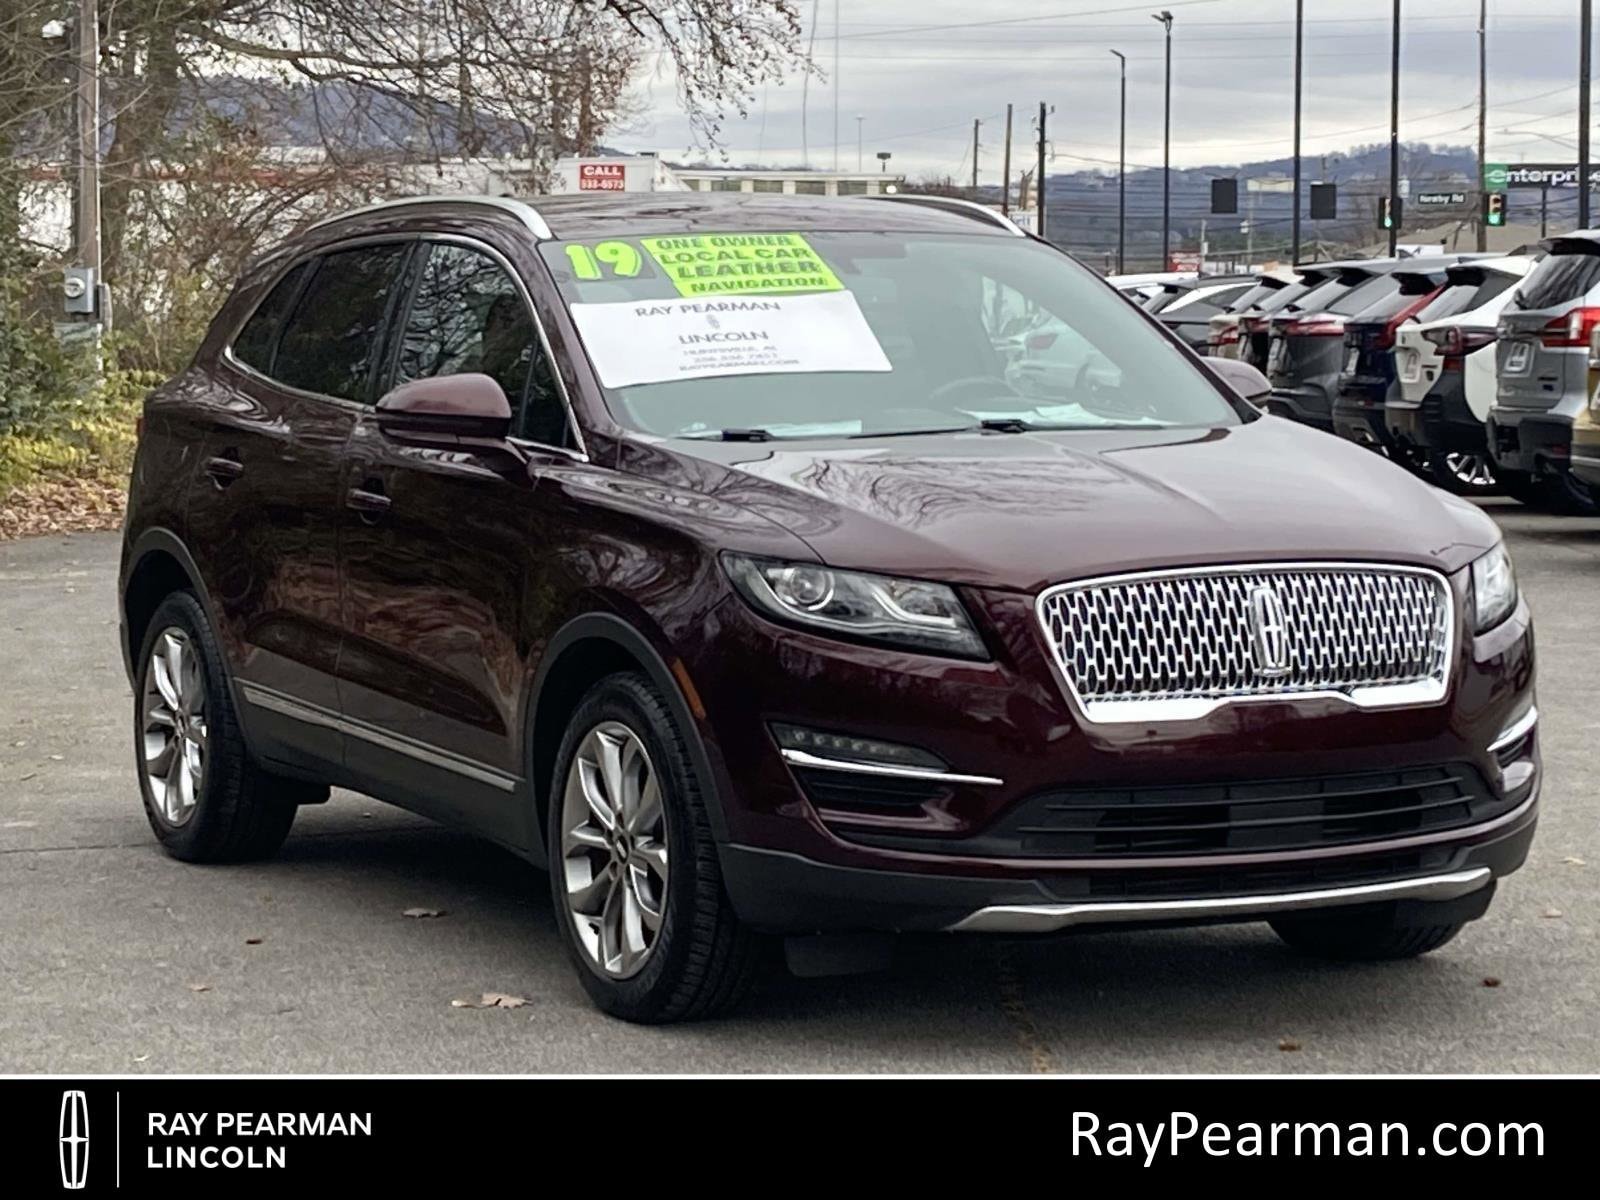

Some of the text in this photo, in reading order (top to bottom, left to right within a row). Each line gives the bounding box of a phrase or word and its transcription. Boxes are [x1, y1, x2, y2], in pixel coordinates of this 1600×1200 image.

[584, 166, 621, 176] CALL
[1484, 167, 1600, 186] enterprie
[656, 235, 794, 250] ONE OWNER
[565, 241, 643, 280] 19
[659, 247, 814, 265] LOCAL CAR
[676, 260, 823, 279] LEATHER
[690, 276, 828, 293] NAVIGATION
[635, 301, 781, 317] RAY PEARMAN
[678, 331, 769, 344] LINCOLN
